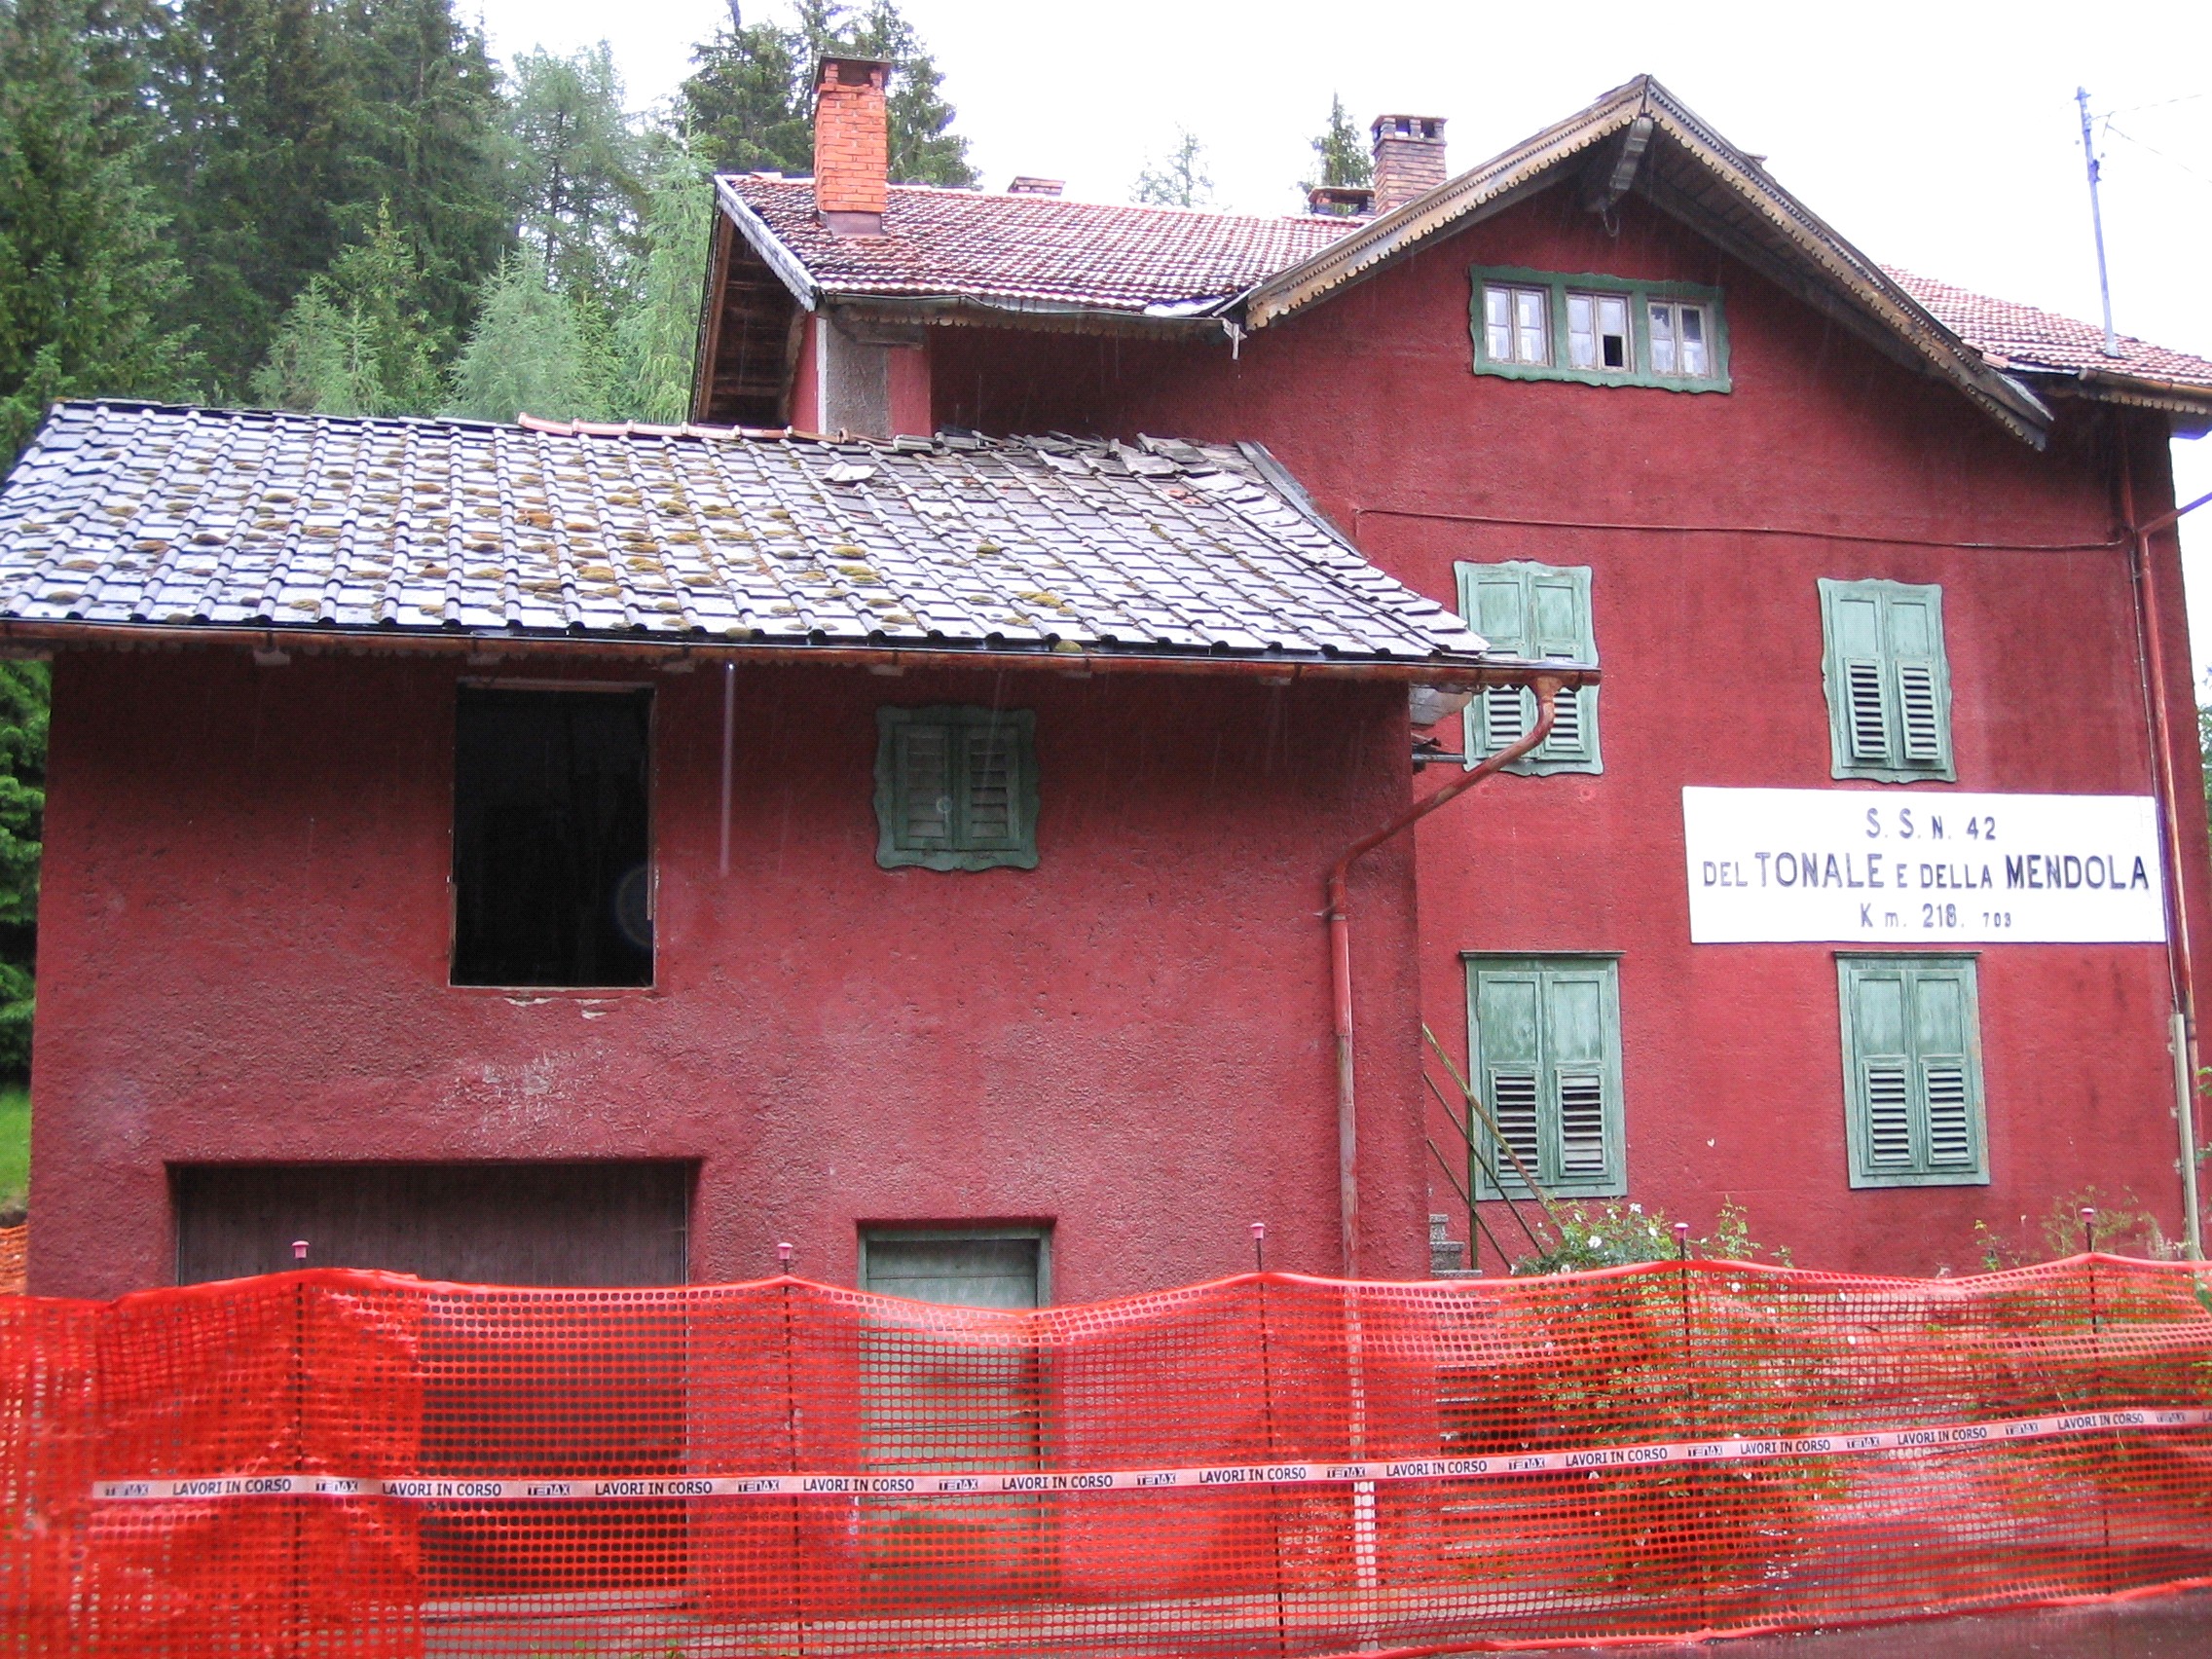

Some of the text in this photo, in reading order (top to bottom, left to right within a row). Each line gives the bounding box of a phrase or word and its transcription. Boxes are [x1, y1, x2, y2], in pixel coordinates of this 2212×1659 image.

[1967, 816, 1996, 840] 42
[1704, 853, 2149, 889] DEL TONALE E DELLA MENDOLA
[1983, 912, 2011, 928] 703
[173, 1480, 222, 1495] LAVORI
[226, 1480, 240, 1493] IN
[245, 1479, 291, 1493] CORSO
[382, 1482, 431, 1496] LAVORI
[437, 1483, 452, 1496] IN
[457, 1483, 501, 1496] CORSO
[595, 1482, 645, 1495] LAVORI
[649, 1482, 663, 1494] IN
[668, 1482, 713, 1494] CORSO
[803, 1479, 849, 1492] LAVORI
[854, 1479, 868, 1491] IN
[872, 1479, 914, 1492] CORSO
[1002, 1477, 1048, 1491] LAVORI
[1052, 1476, 1066, 1489] IN
[1071, 1475, 1113, 1488] CORSO
[1199, 1470, 1245, 1483] LAVORI
[1249, 1469, 1263, 1481] IN
[1268, 1467, 1307, 1481] CORSO
[1386, 1463, 1429, 1477] LAVORI
[1433, 1463, 1445, 1474] IN
[1449, 1461, 1488, 1474] CORSO
[1566, 1453, 1607, 1467] LAVORI
[1611, 1452, 1624, 1462] IN
[1628, 1448, 1668, 1462] CORSO
[1740, 1442, 1776, 1455] LAVORI
[1780, 1441, 1792, 1453] IN
[1795, 1440, 1830, 1452] CORSO
[1898, 1430, 1935, 1445] LAVORI
[1938, 1429, 1949, 1442] IN
[1952, 1427, 1987, 1440] CORSO
[2057, 1417, 2097, 1431] LAVORI
[2098, 1416, 2110, 1426] IN
[2113, 1413, 2144, 1424] CORSO
